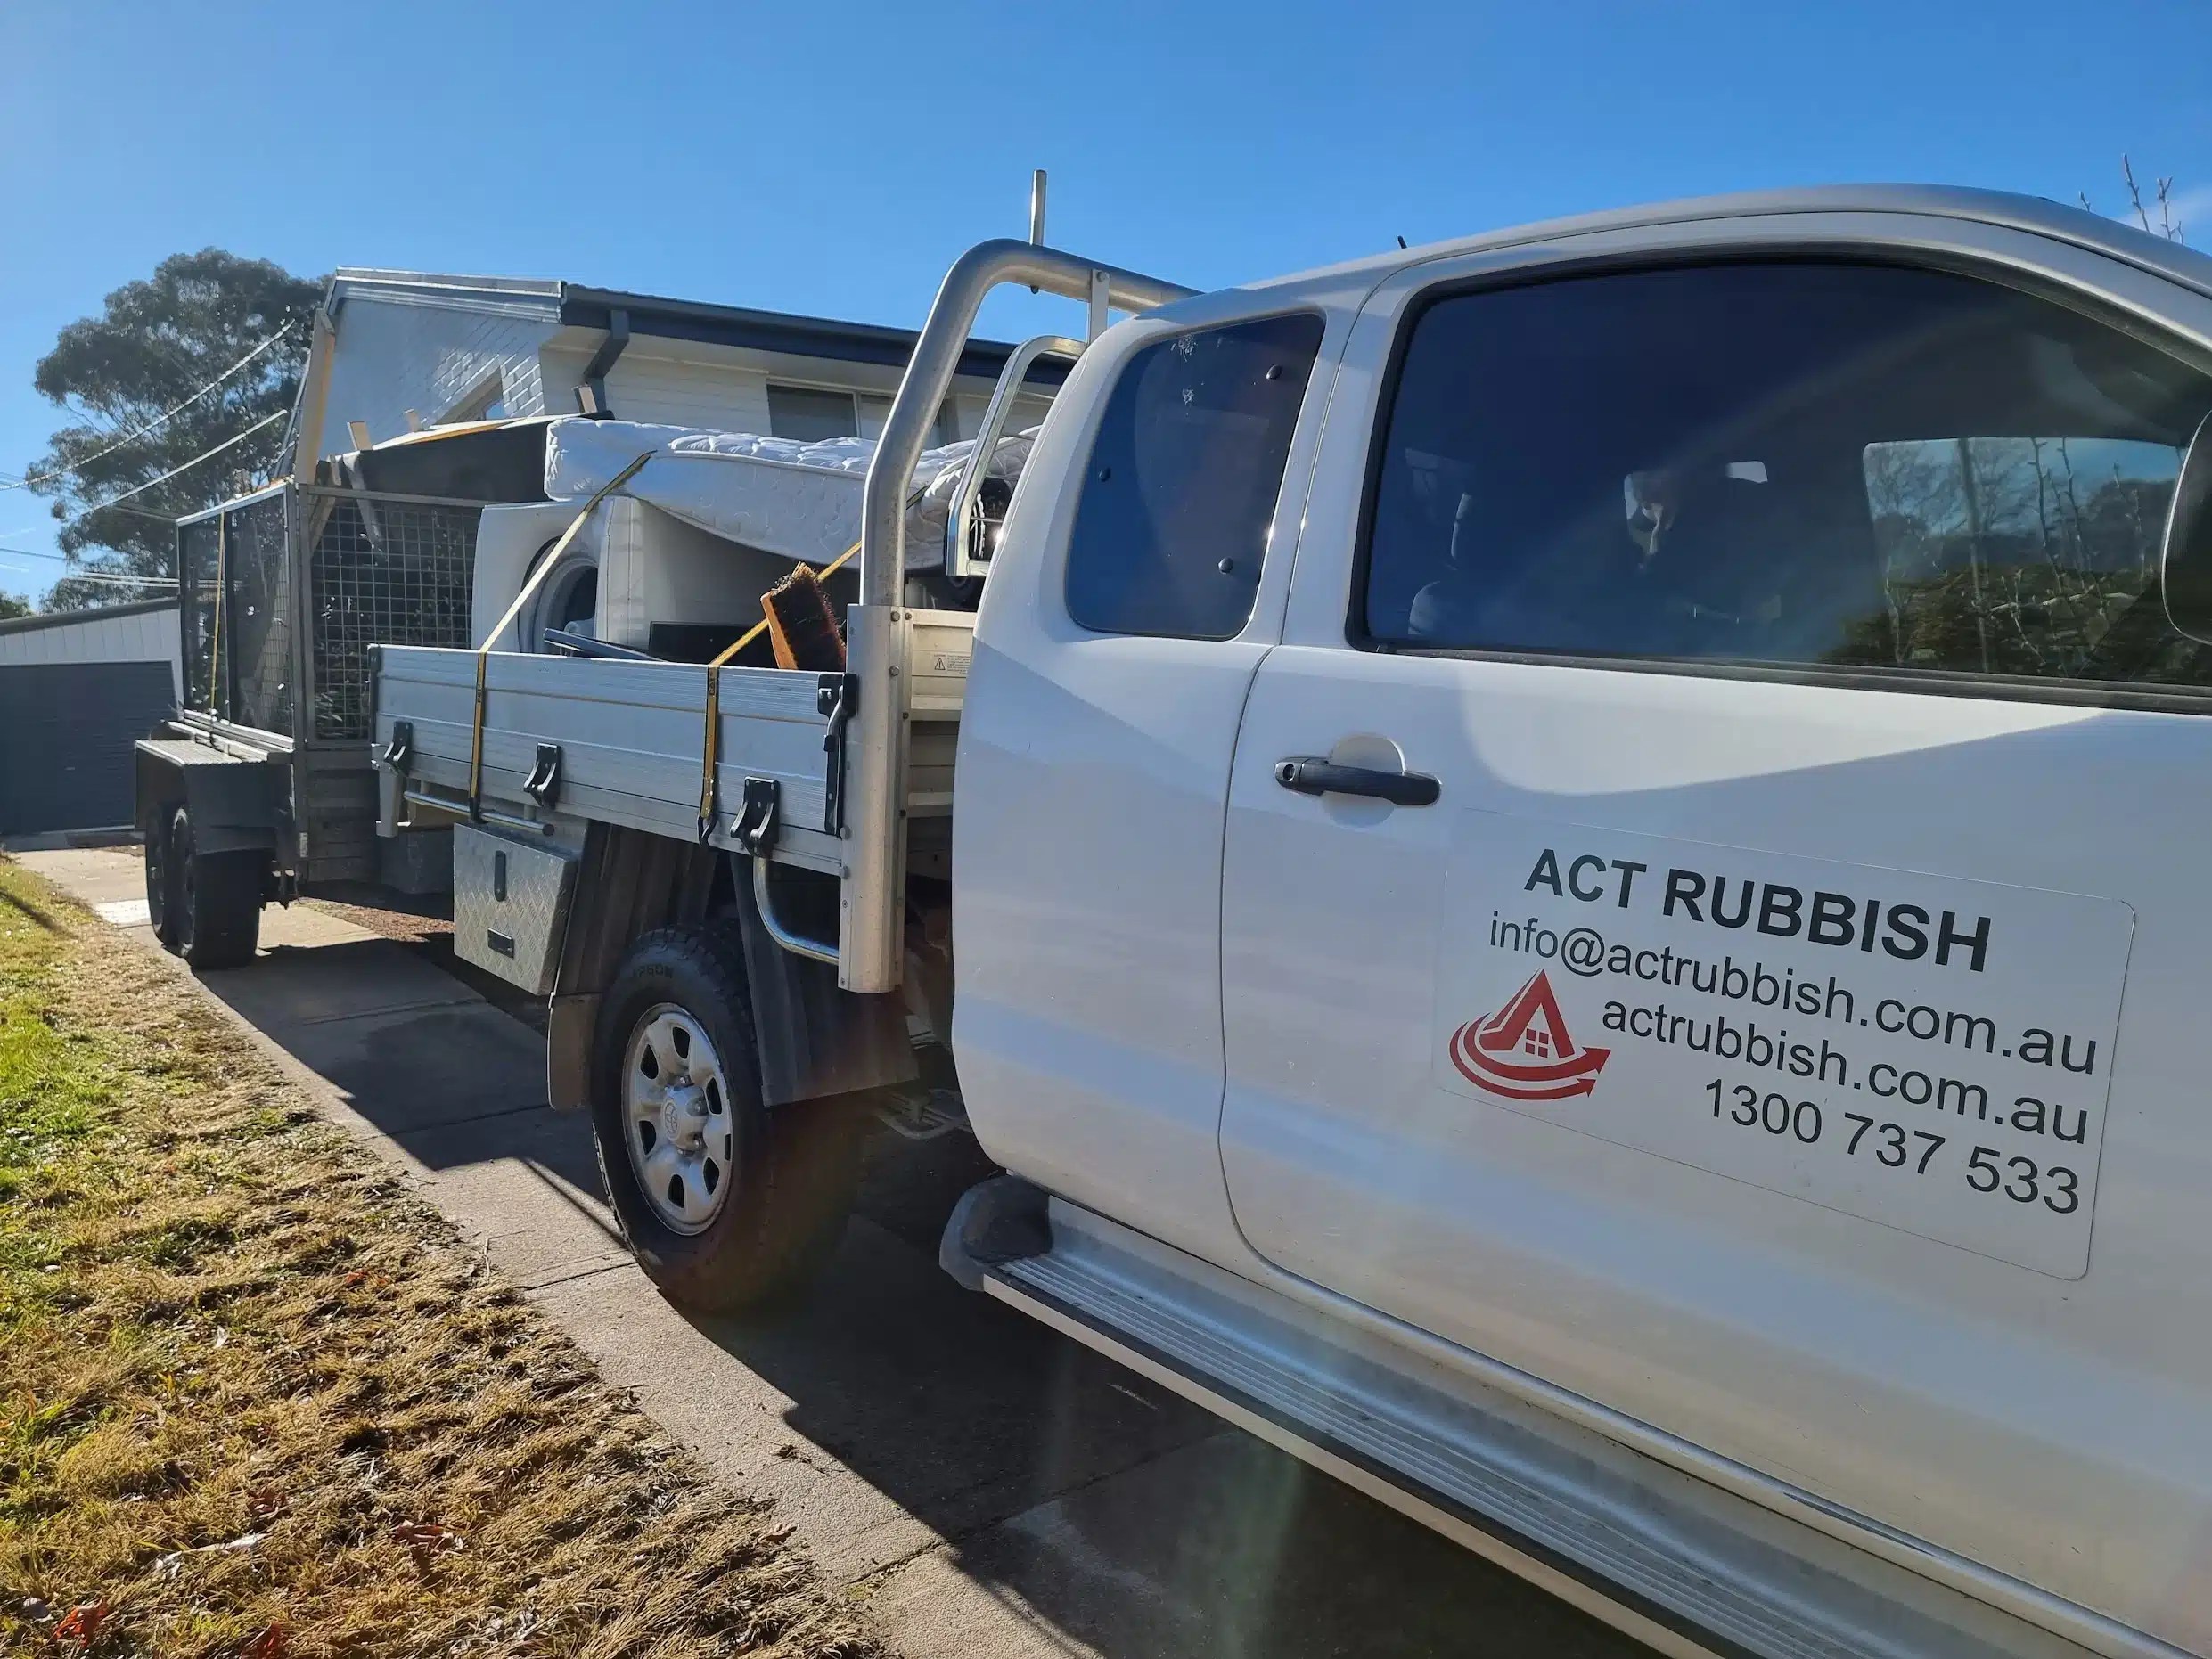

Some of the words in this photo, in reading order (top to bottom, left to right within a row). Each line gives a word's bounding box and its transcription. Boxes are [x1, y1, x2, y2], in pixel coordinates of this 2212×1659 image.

[1523, 848, 1648, 909] ACT
[1662, 868, 1992, 973] RUBBISH
[1489, 911, 2097, 1075] info@actrubbish.com.au
[1602, 1001, 2089, 1145] actrubbish.com.au
[1705, 1078, 1823, 1145] 1300
[1844, 1111, 1946, 1175] 737
[1966, 1145, 2080, 1214] 533
